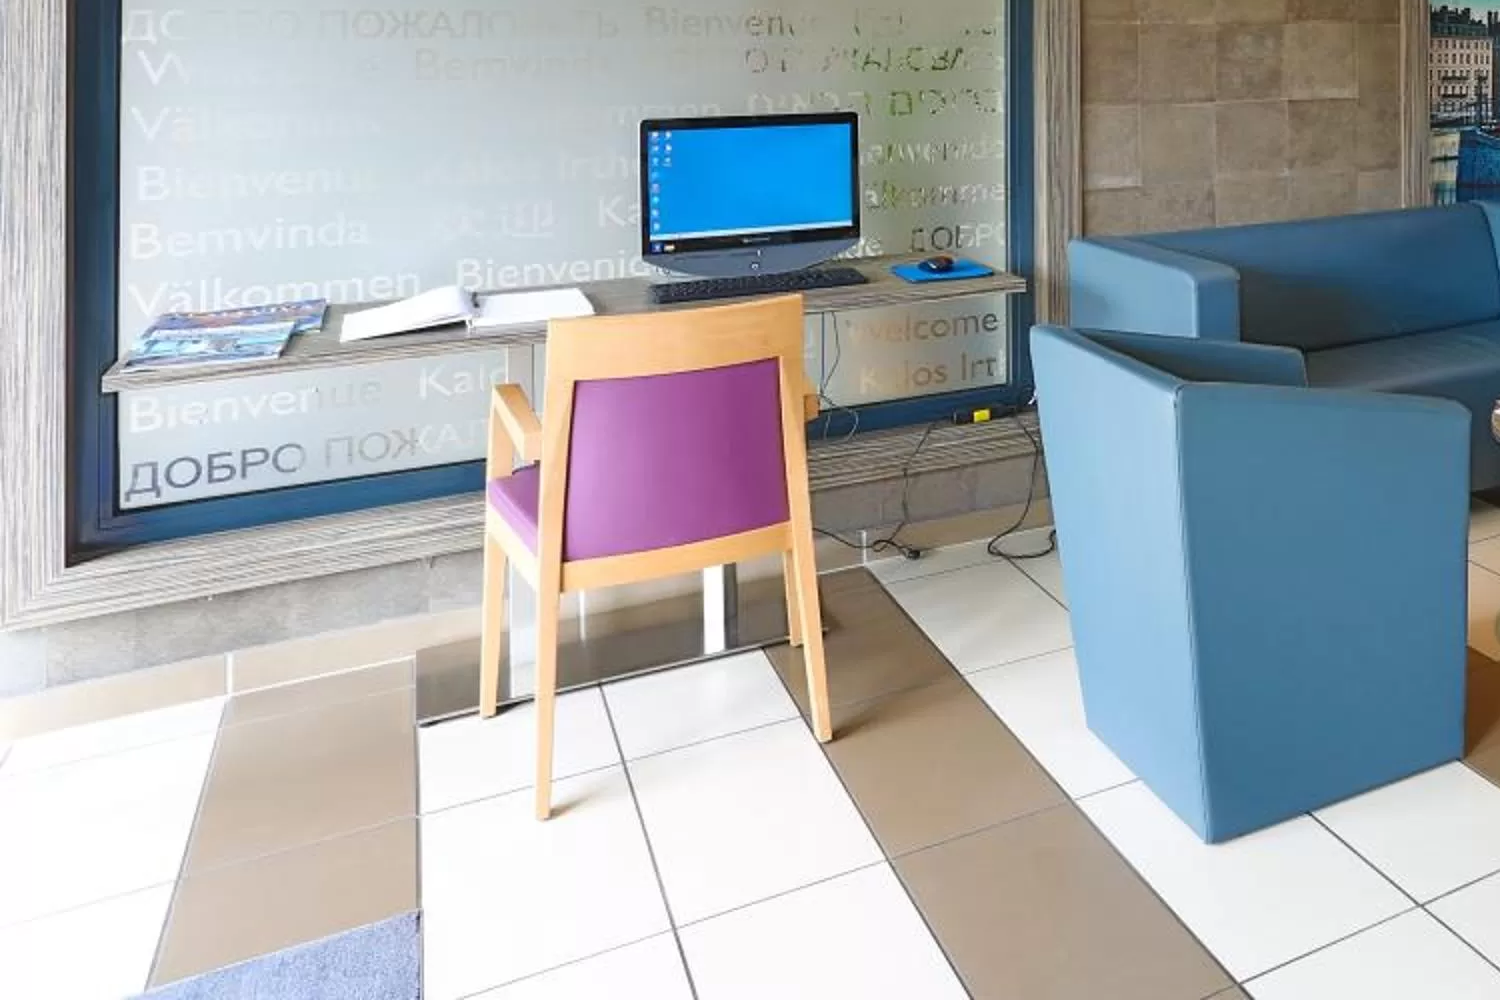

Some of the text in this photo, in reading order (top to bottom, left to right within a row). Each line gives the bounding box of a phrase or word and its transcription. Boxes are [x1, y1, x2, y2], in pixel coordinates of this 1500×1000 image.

[129, 211, 369, 261] Bemvinda
[128, 268, 421, 318] Välkommen
[127, 378, 384, 434] Bienvenue
[124, 442, 306, 501] ДОБРО
